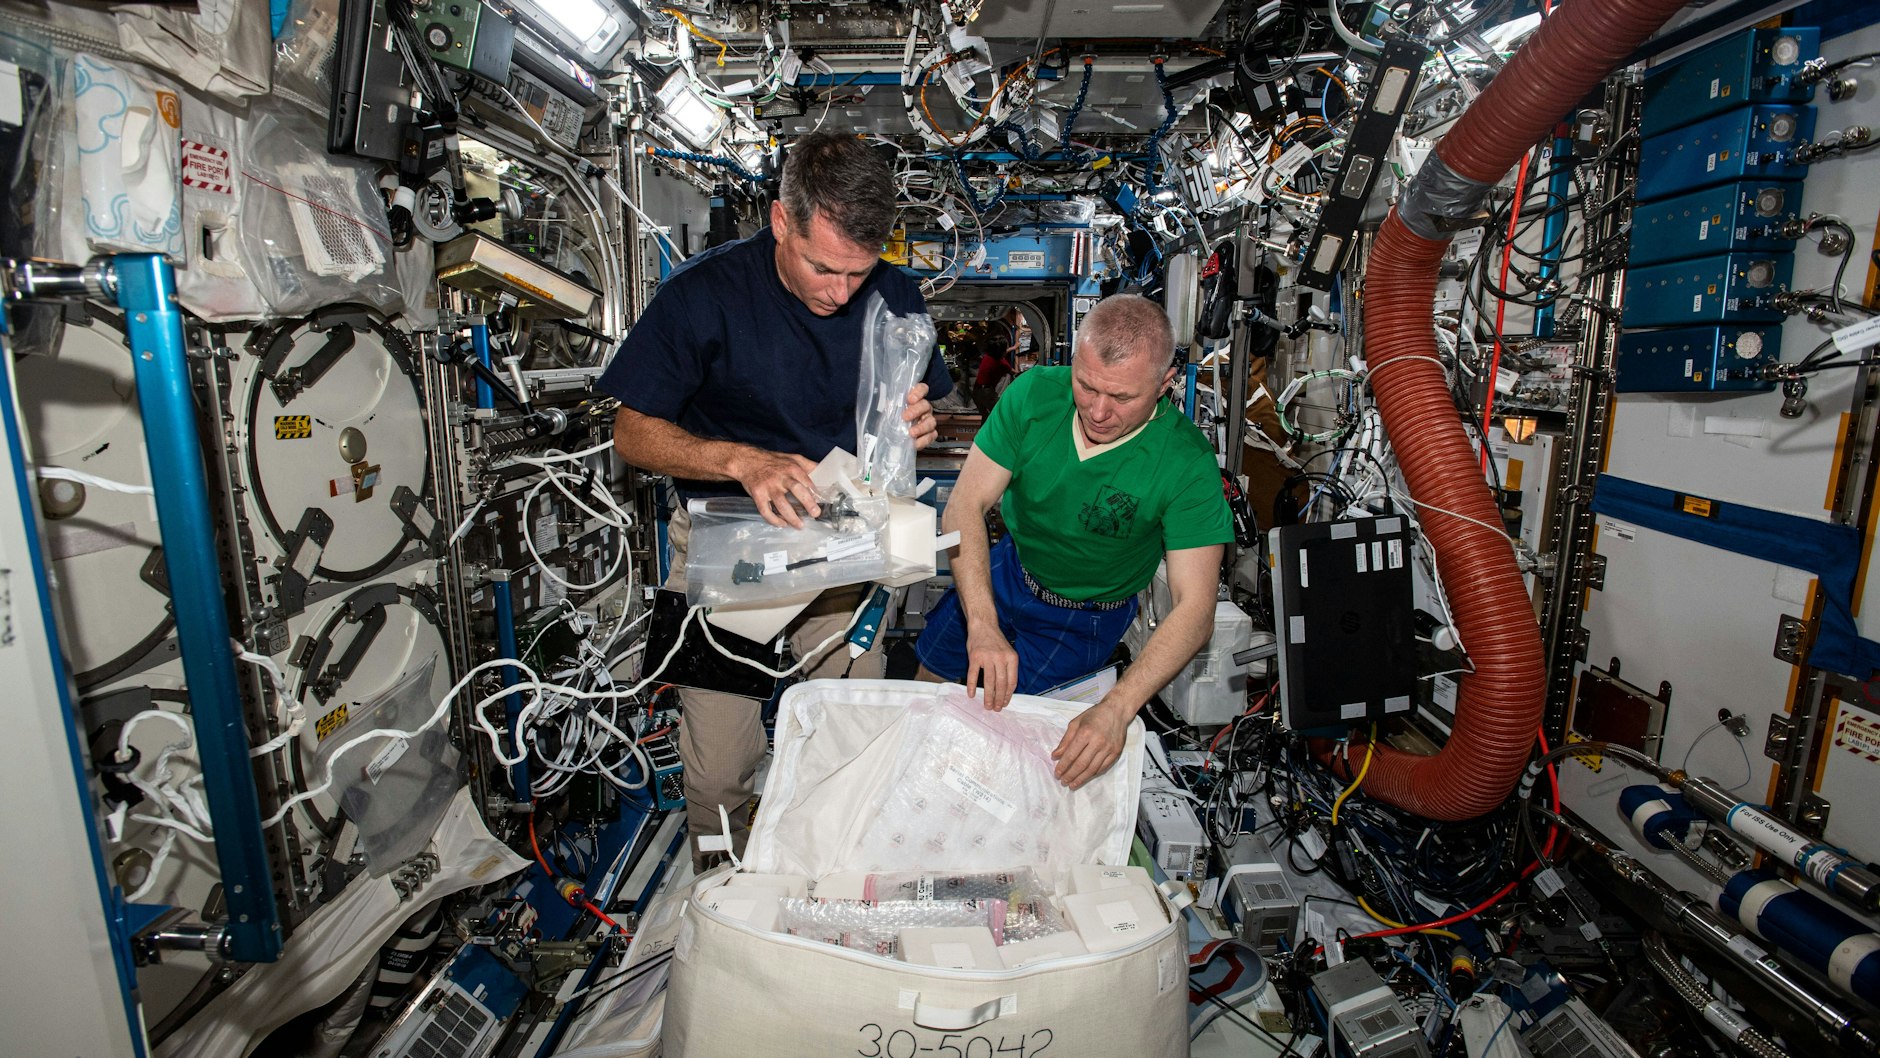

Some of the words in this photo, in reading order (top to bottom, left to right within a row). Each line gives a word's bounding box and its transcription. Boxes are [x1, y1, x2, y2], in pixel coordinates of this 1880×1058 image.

[190, 160, 206, 171] FIRE
[208, 165, 224, 176] PORT
[1845, 728, 1863, 740] FIRE
[1846, 721, 1877, 736] EMERGENCY
[950, 765, 964, 777] Serial
[965, 776, 1005, 805] Communications
[957, 778, 972, 789] Cable
[1740, 808, 1752, 818] For
[1752, 815, 1765, 825] ISS
[1765, 821, 1778, 833] Use
[1779, 831, 1797, 843] Only
